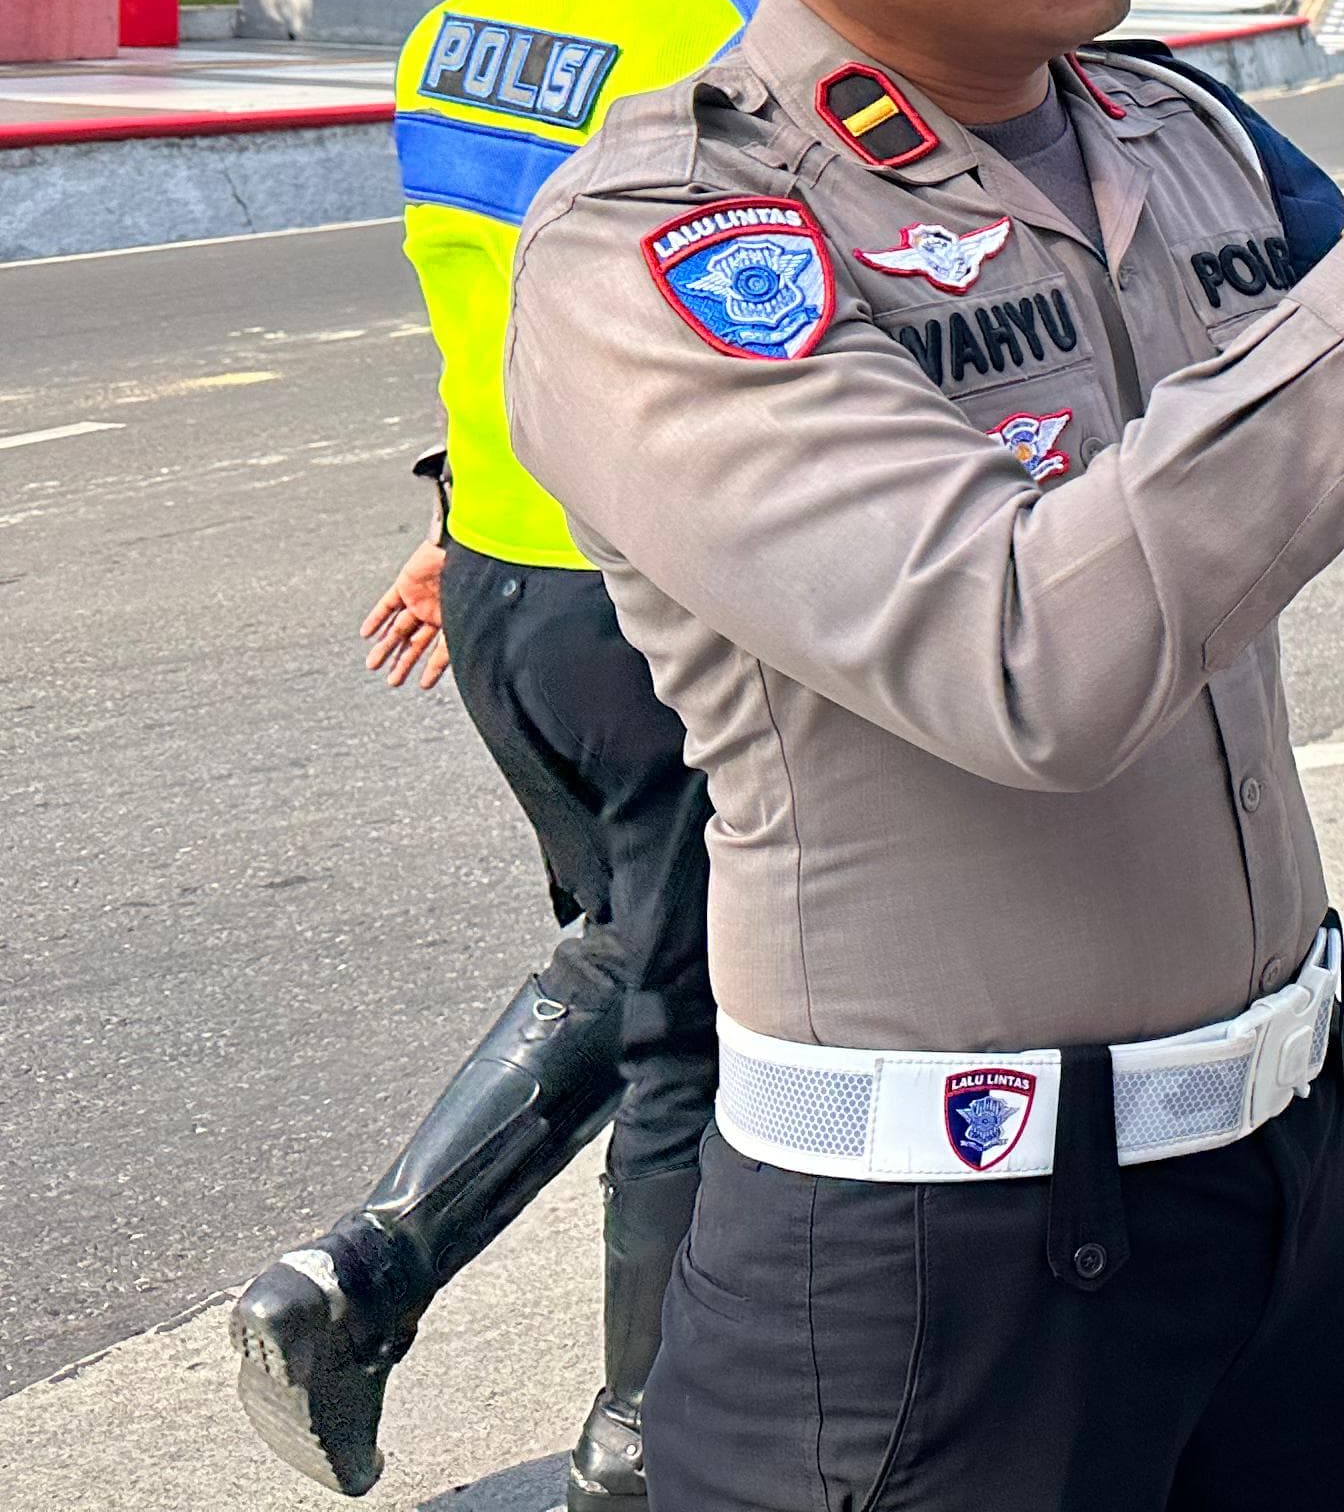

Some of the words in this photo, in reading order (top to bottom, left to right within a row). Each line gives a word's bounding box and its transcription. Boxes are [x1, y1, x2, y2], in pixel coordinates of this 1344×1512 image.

[653, 217, 715, 257] LALU
[715, 208, 802, 230] LINTAS
[1190, 237, 1299, 309] POLR
[951, 1074, 984, 1091] LALU
[986, 1073, 1031, 1090] LINTAS
